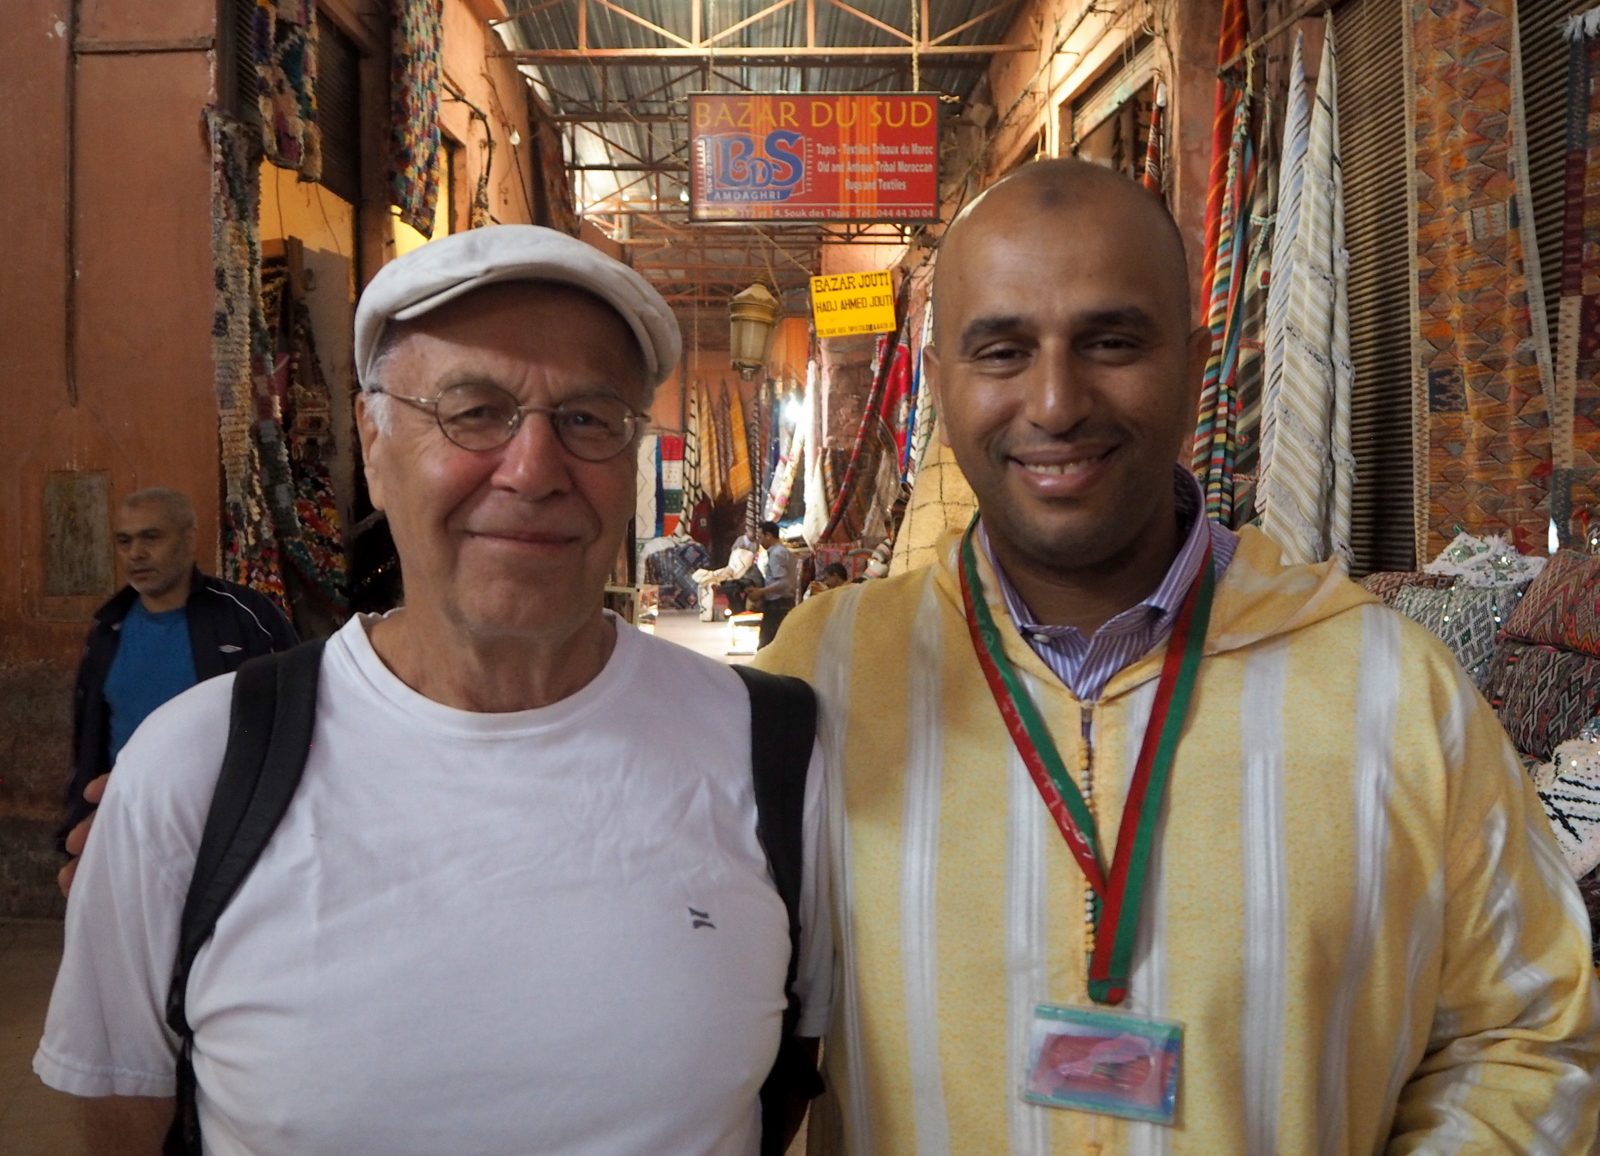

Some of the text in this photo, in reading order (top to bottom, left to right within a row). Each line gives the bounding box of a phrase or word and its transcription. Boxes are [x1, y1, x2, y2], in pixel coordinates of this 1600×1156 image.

[695, 101, 932, 128] BAZAR DU SUD
[816, 143, 836, 157] Tapis
[872, 143, 899, 155] Tribaux
[900, 143, 910, 155] du
[911, 143, 934, 155] Maroc
[817, 160, 830, 172] Old
[831, 160, 844, 172] and
[876, 160, 896, 172] Tribal
[897, 160, 933, 172] Moroccan
[878, 178, 906, 190] Textiles
[713, 190, 781, 200] AMDAGHRI
[784, 208, 806, 217] Souk
[809, 208, 824, 217] des
[827, 208, 849, 219] Tapis
[877, 208, 893, 217] 044
[896, 208, 907, 217] 44
[909, 208, 920, 217] 30
[921, 208, 933, 217] 04
[814, 272, 889, 293] BAZAR JOUTI
[816, 294, 892, 313] HADJ AHMED JOUTI
